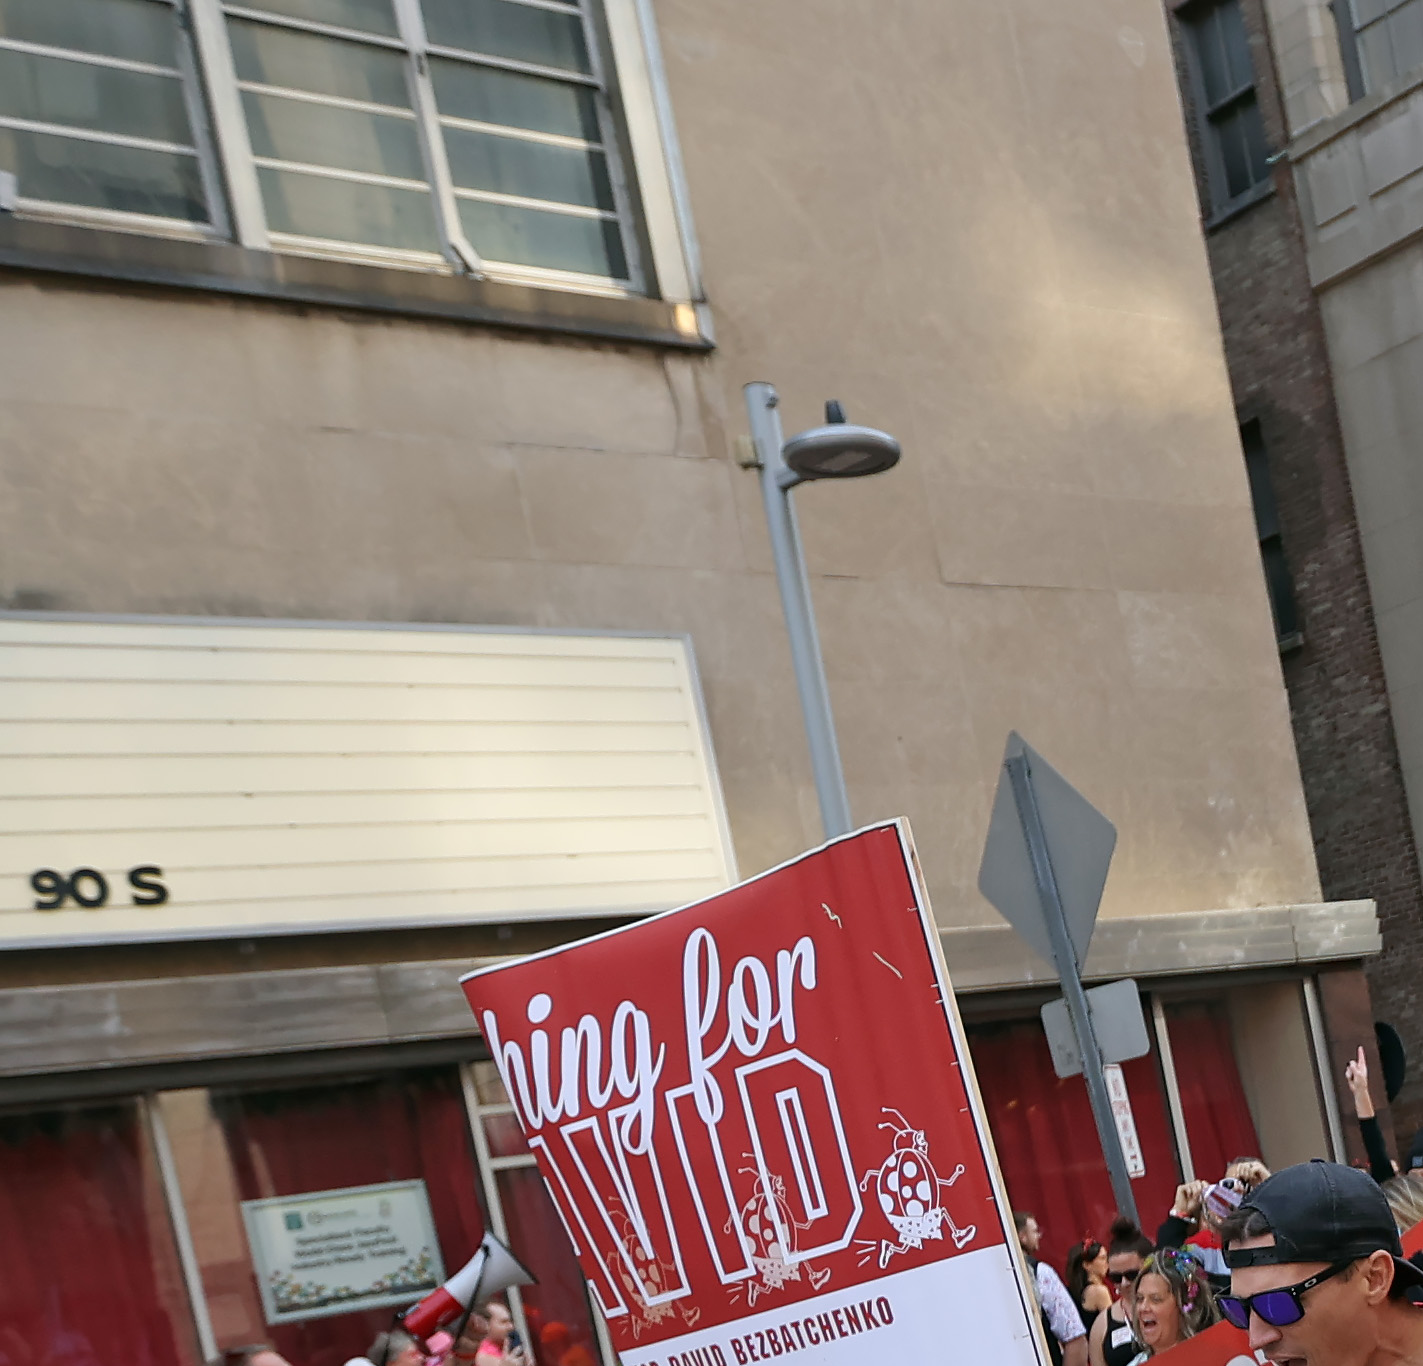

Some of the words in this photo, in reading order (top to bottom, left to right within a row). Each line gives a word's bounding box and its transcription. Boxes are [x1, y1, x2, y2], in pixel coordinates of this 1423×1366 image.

[31, 869, 109, 910] 90
[128, 865, 169, 906] S
[683, 926, 817, 1126] for
[730, 1295, 895, 1366] BEZBATCHENKO
